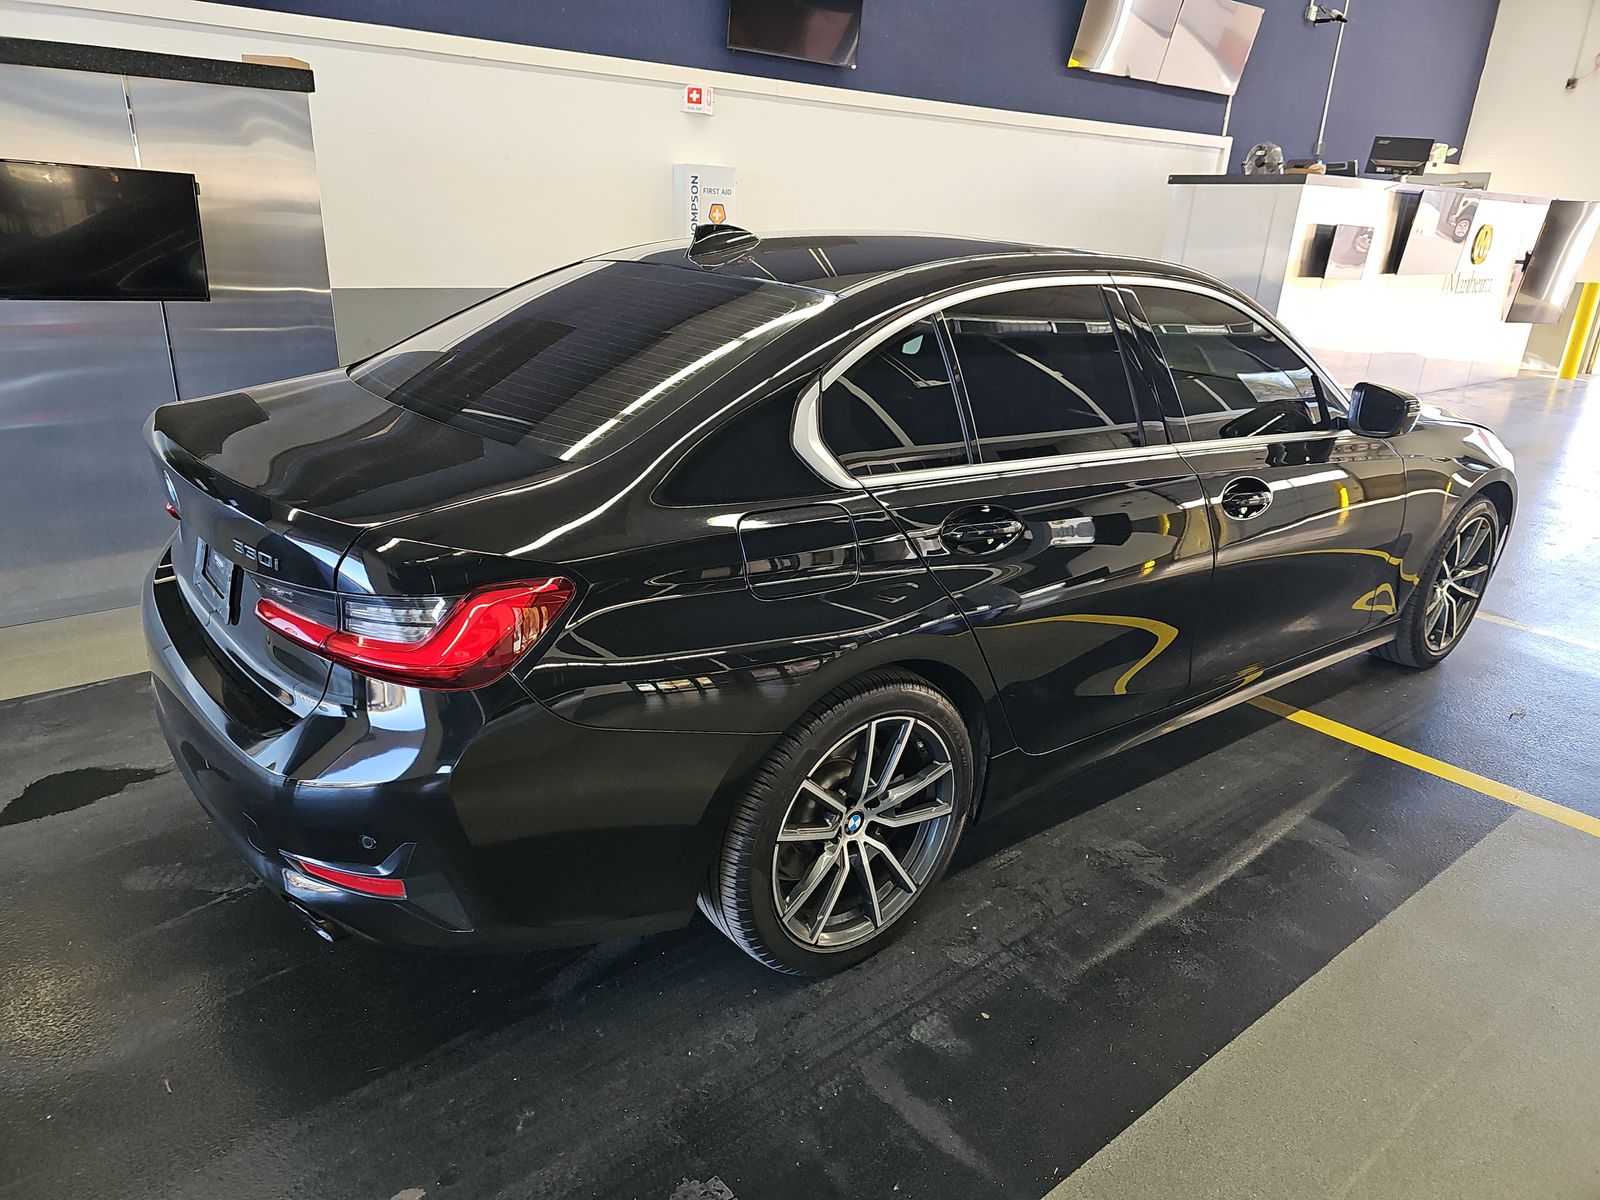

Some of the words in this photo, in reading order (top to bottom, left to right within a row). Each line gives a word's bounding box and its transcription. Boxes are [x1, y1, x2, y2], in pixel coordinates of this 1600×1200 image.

[690, 175, 699, 235] OMPSON
[702, 187, 720, 195] FIRST
[721, 188, 732, 196] AID
[232, 538, 279, 571] 330i
